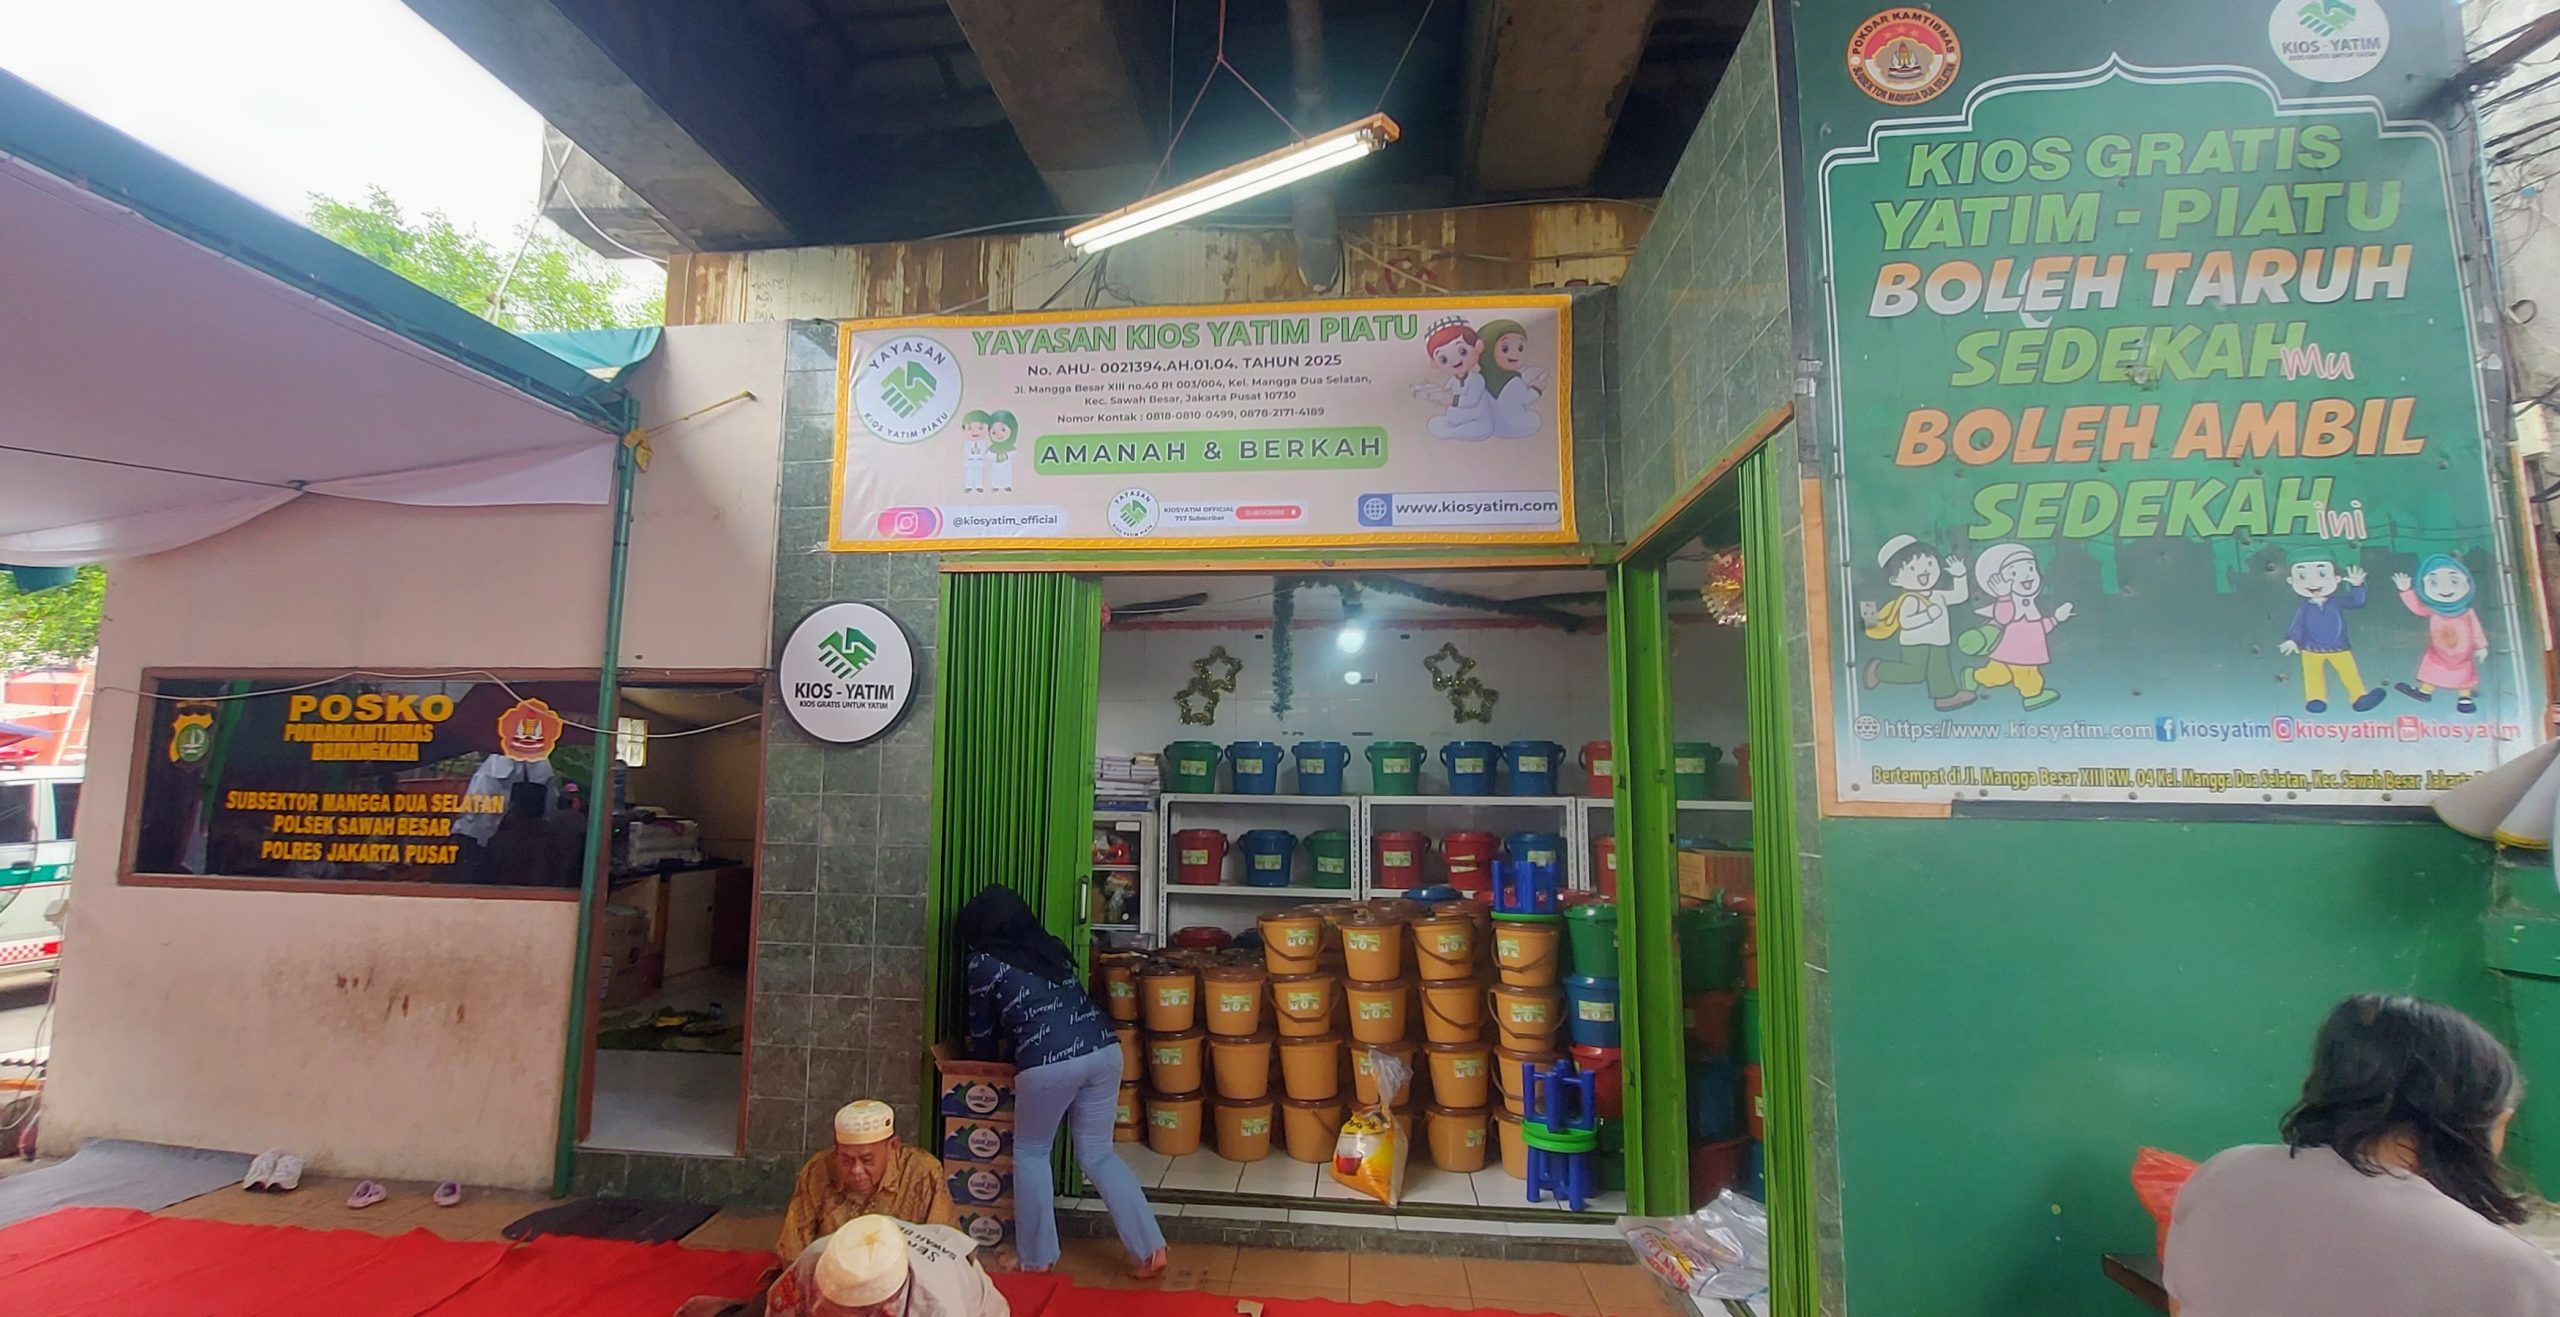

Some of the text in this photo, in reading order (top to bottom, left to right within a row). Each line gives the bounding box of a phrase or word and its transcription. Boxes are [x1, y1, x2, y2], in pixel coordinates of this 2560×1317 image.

[1853, 15, 1889, 55] POKDAR
[2282, 40, 2320, 55] KIOS
[2329, 37, 2381, 51] YATIM
[1906, 123, 2343, 187] KIOS GRATIS
[1873, 192, 2099, 252] YATIM
[2158, 180, 2402, 241] PIATU
[1868, 244, 2413, 319] BOLEH TARUH
[972, 314, 1417, 356] YAYASAN KIOS YATIM PIATU
[869, 342, 946, 369] YAYASAN
[1028, 365, 1051, 376] No.
[1243, 356, 1299, 368] TAHUN
[1304, 355, 1342, 366] 2025
[1029, 386, 1071, 395] Mangga
[1075, 384, 1104, 393] Besar
[1252, 377, 1297, 388] Mangga
[1301, 376, 1322, 385] Dua
[1085, 397, 1107, 406] Kec.
[1110, 396, 1145, 405] Sawah
[1186, 393, 1226, 403] Jakarta
[1231, 392, 1261, 401] Pusat
[1265, 391, 1296, 400] 10730
[922, 412, 948, 434] PIATU
[1058, 415, 1094, 424] Nomor
[1098, 413, 1137, 423] Kontak
[1896, 396, 2426, 468] BOLEH AMBIL
[1040, 437, 1381, 465] AMANAH & BERKAH
[1395, 499, 1558, 515] www.kiosyatim.com
[953, 513, 1058, 529] @kiosyatim_official
[795, 682, 832, 699] KIOS
[845, 684, 894, 700] YATIM
[289, 694, 454, 722] POSKO
[2180, 717, 2271, 742] kiosyatim
[2296, 716, 2395, 742] kiosyatim
[1872, 766, 1946, 789] Bertempat
[1949, 766, 1963, 785] di
[1981, 767, 2037, 790] Mangga
[2039, 768, 2078, 786] Besar
[2079, 768, 2104, 786] XIII
[2106, 768, 2135, 787] RW.
[2136, 768, 2154, 787] 04
[2157, 768, 2181, 788] Kel.
[2183, 768, 2232, 791] Mangga
[2234, 769, 2260, 789] Dua
[2312, 769, 2340, 789] Kec.
[2341, 769, 2383, 790] Sawah
[2385, 770, 2421, 790] Besar
[226, 790, 504, 814] SUBSEKTOR MANGGA DUA SELATAN
[273, 814, 451, 836] POLSEK SAWAH BESAR
[261, 841, 459, 864] POLRES JAKARTA PUSAT
